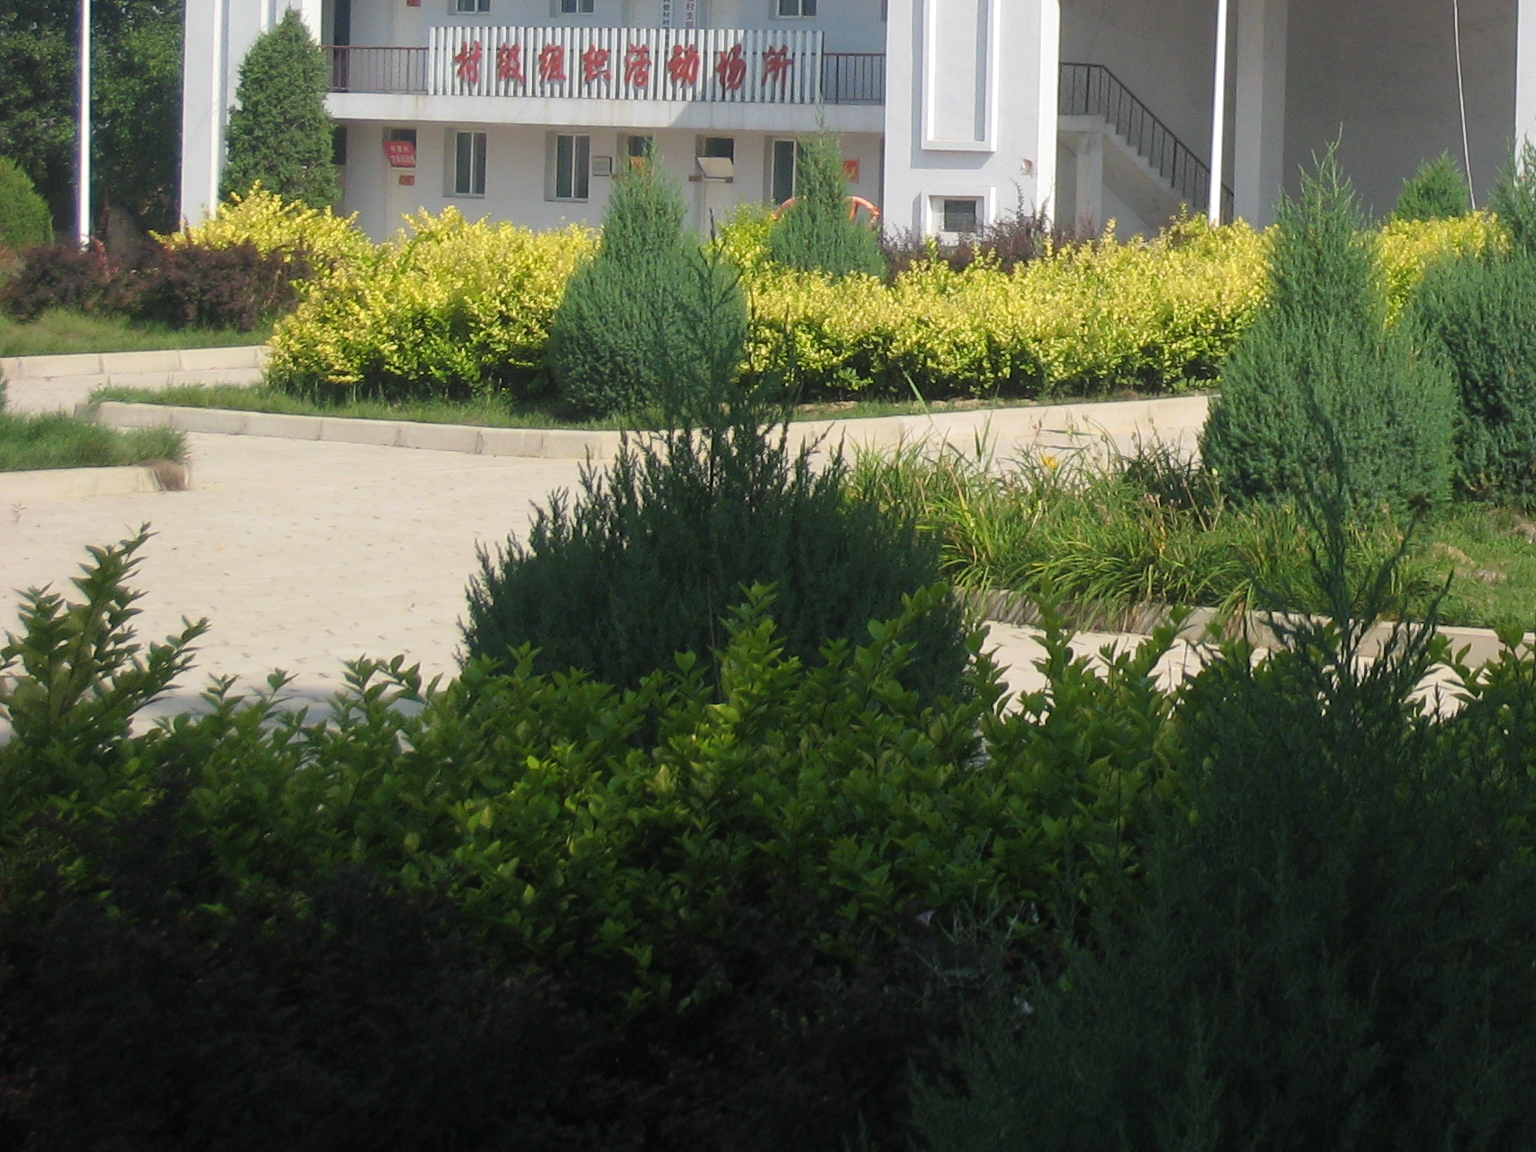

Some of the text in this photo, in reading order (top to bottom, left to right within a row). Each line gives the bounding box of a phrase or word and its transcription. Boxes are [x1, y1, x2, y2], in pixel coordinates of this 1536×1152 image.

[454, 40, 795, 92] 村级组织活动场所
